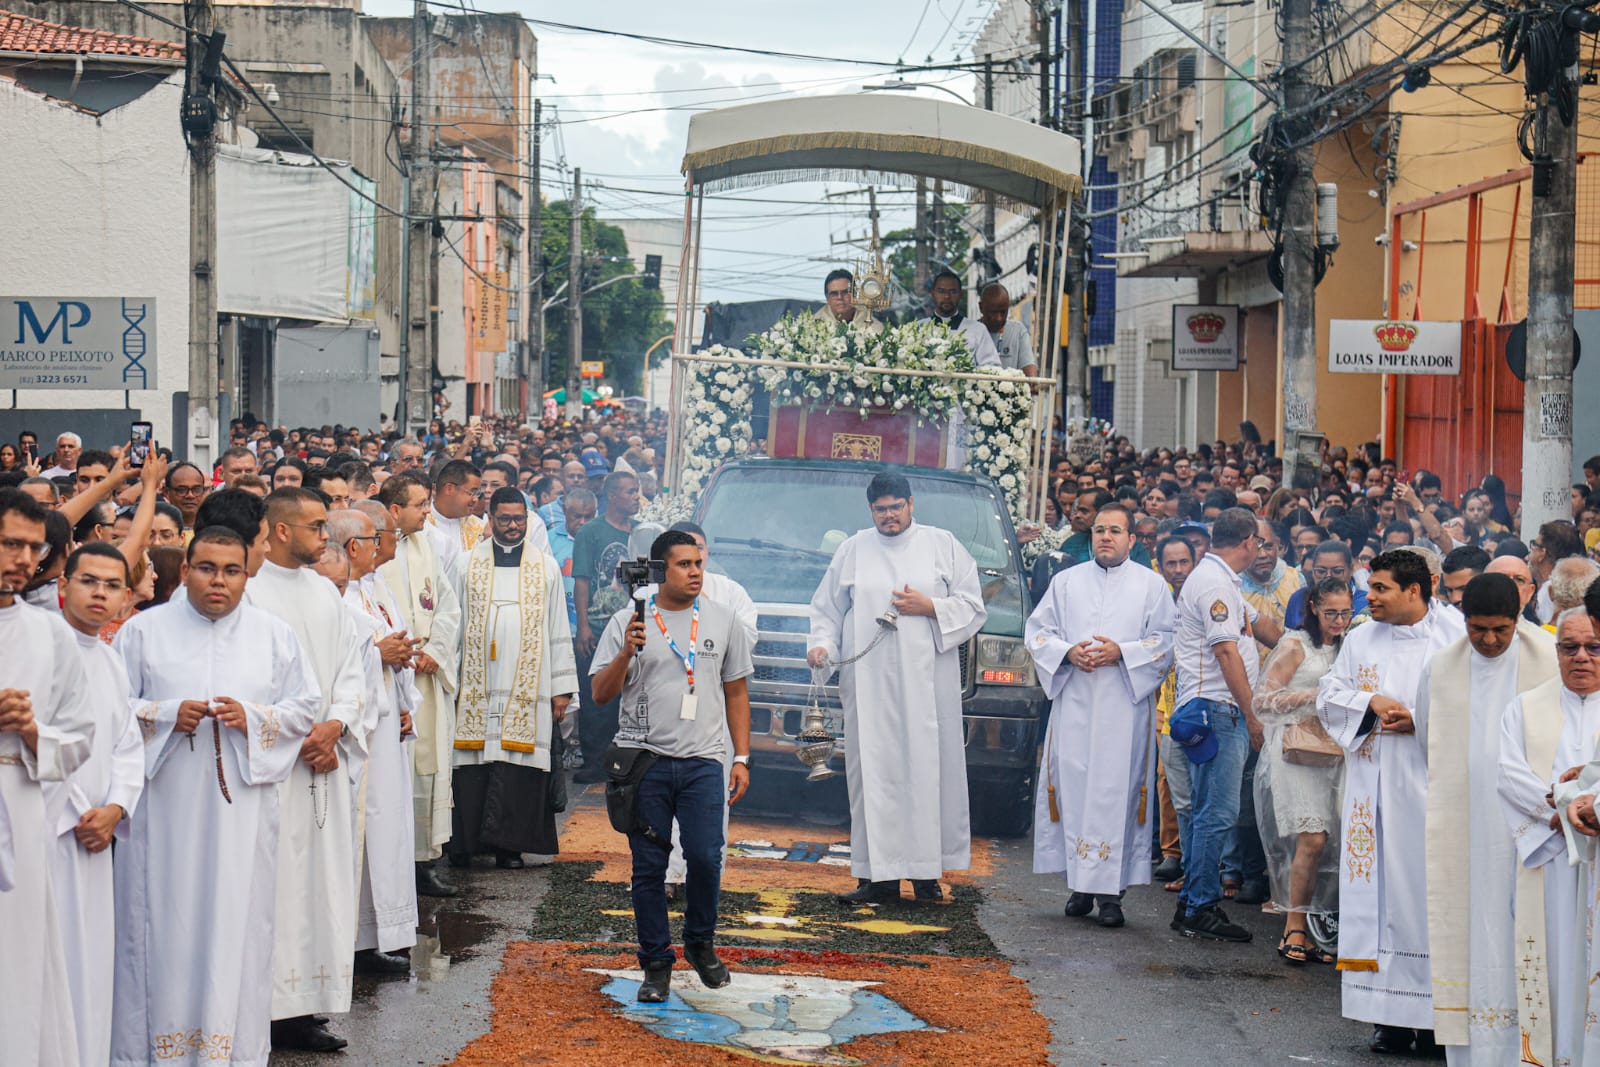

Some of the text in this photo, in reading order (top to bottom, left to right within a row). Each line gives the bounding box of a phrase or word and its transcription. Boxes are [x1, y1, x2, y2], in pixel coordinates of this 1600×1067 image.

[13, 301, 91, 344] MP
[50, 350, 114, 363] PEIXOTO
[1335, 353, 1454, 367] LOJAS IMPERADOR
[36, 375, 61, 383] 3223
[63, 375, 88, 383] 6571
